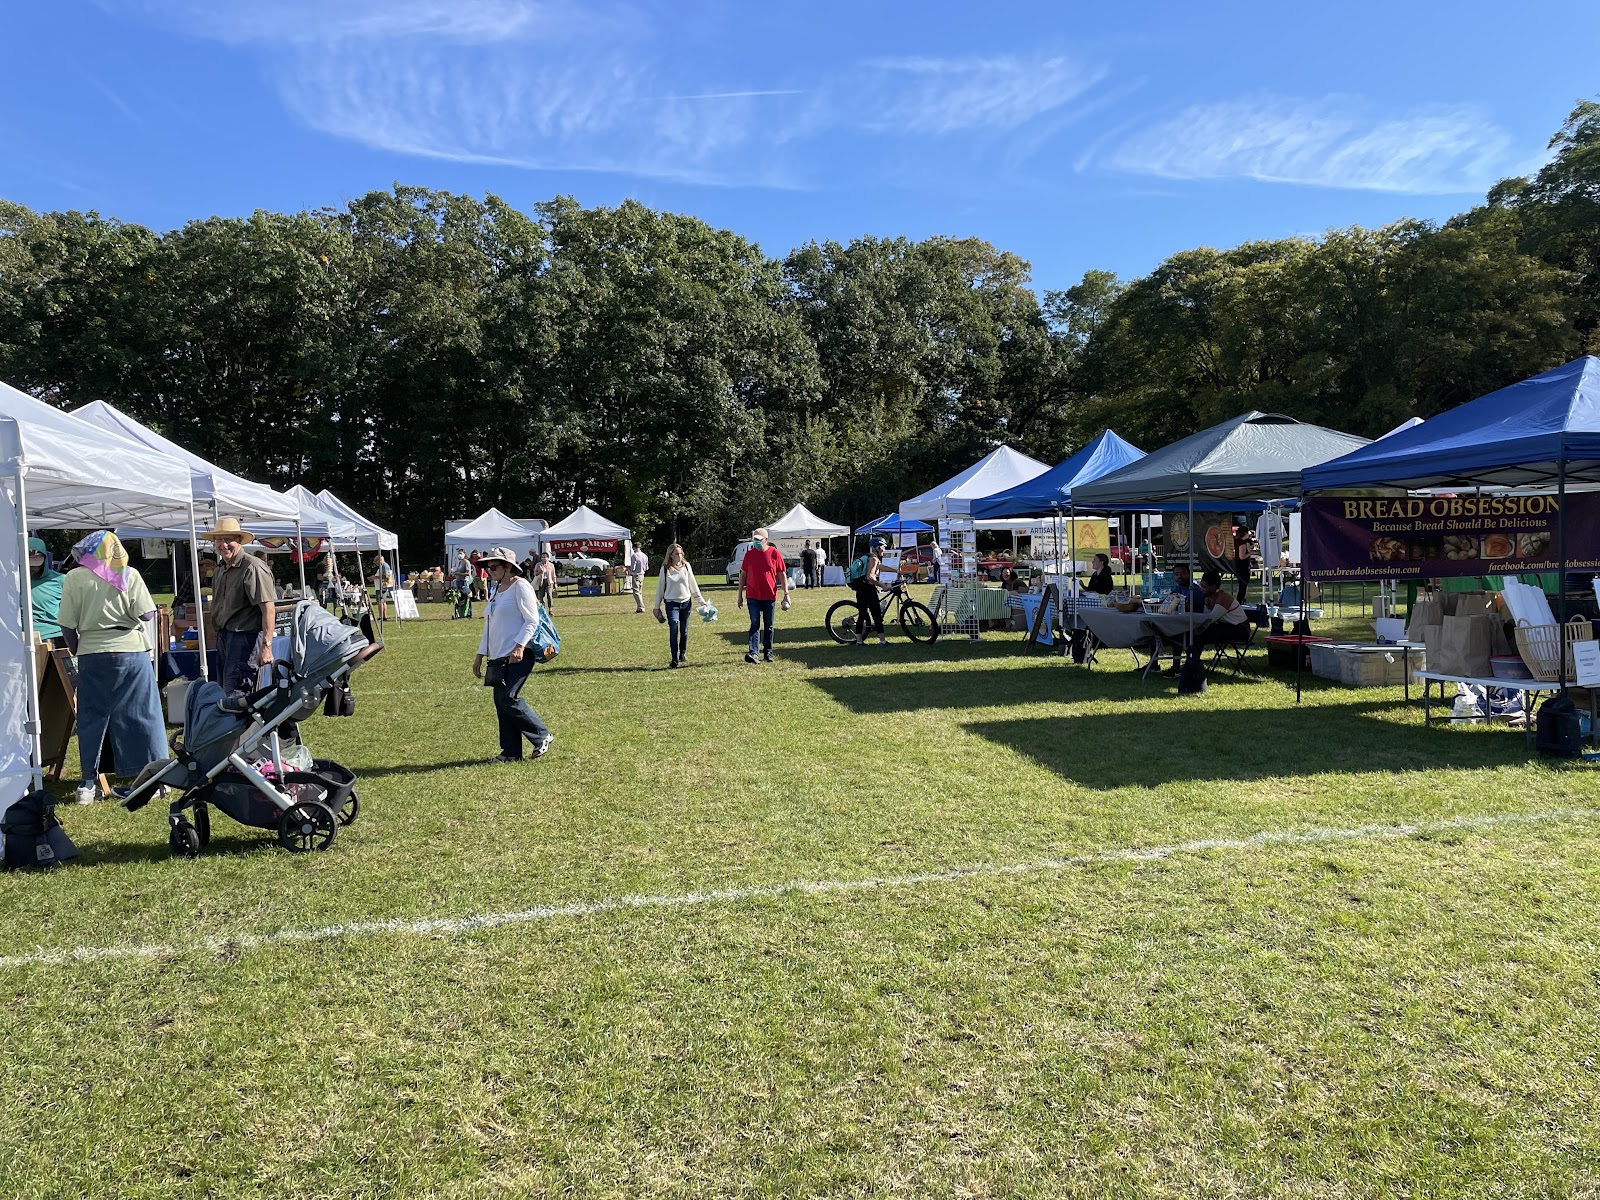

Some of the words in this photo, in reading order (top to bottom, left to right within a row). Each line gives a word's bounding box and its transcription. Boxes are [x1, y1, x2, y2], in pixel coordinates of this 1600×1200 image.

[1343, 499, 1424, 519] BREAD
[1430, 496, 1559, 517] OBSESSION
[1373, 521, 1412, 532] Because
[1415, 519, 1444, 531] Bread
[1446, 518, 1481, 530] Should
[1484, 518, 1497, 529] Be
[1499, 517, 1547, 528] Delicious
[554, 541, 578, 550] BUSA
[1311, 565, 1420, 577] www.breadobsession.com
[1488, 558, 1600, 574] facebook.com/bredobsessi
